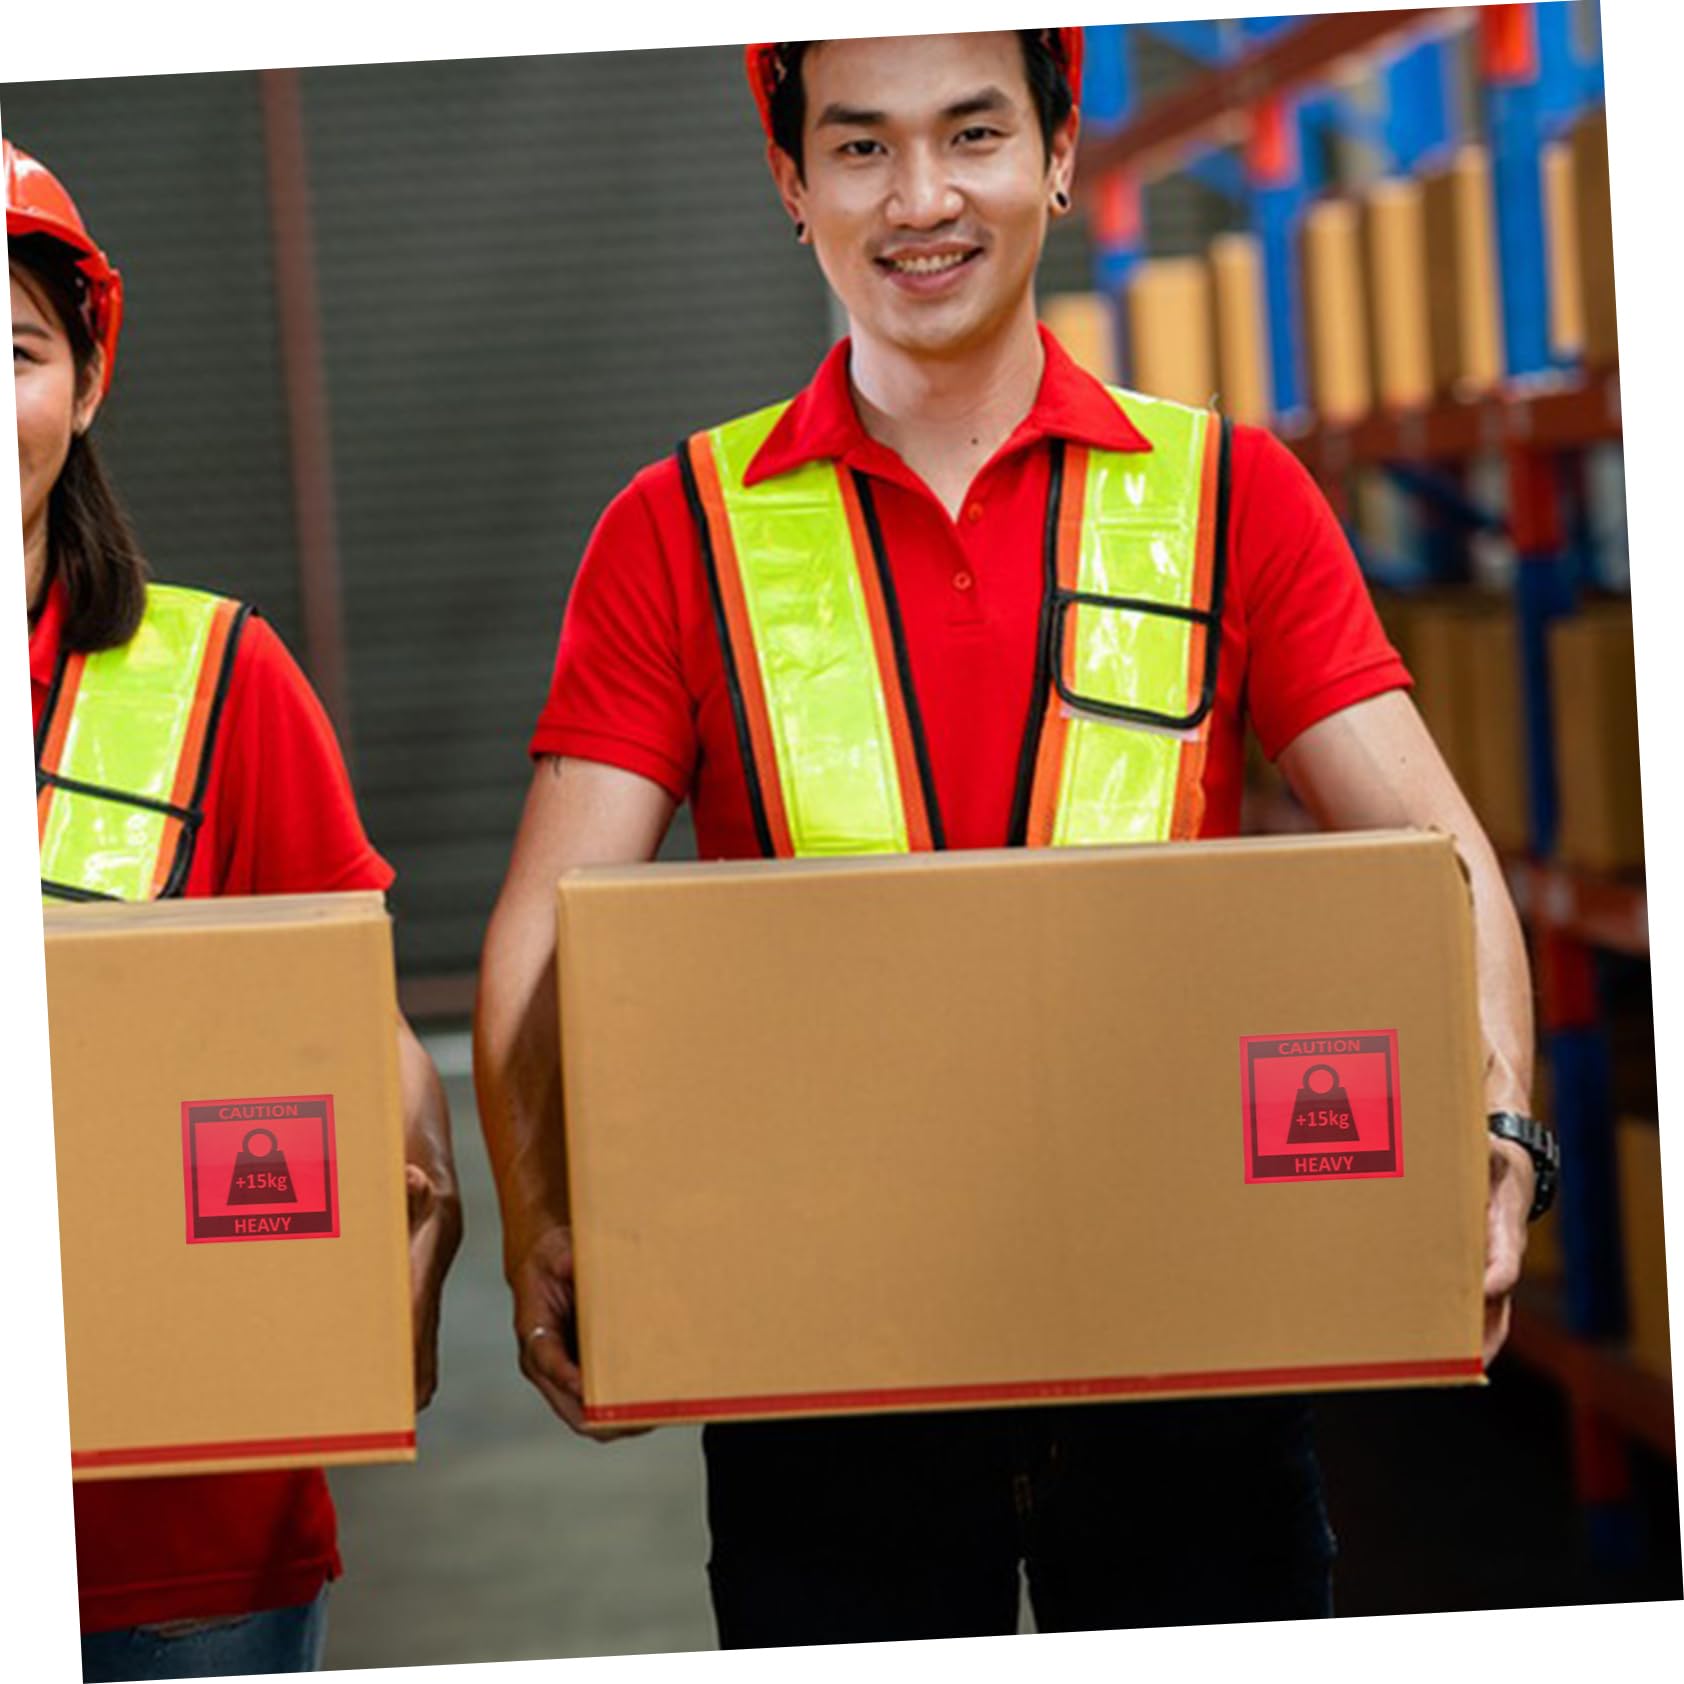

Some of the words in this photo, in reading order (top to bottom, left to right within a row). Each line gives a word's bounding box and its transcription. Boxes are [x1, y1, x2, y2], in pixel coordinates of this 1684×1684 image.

[1278, 1040, 1360, 1055] CAUTION
[218, 1104, 298, 1119] CAUTION
[1296, 1110, 1350, 1129] +15kg
[1295, 1156, 1354, 1173] HEAVY
[235, 1172, 288, 1191] +15kg
[235, 1217, 291, 1233] HEAVY
